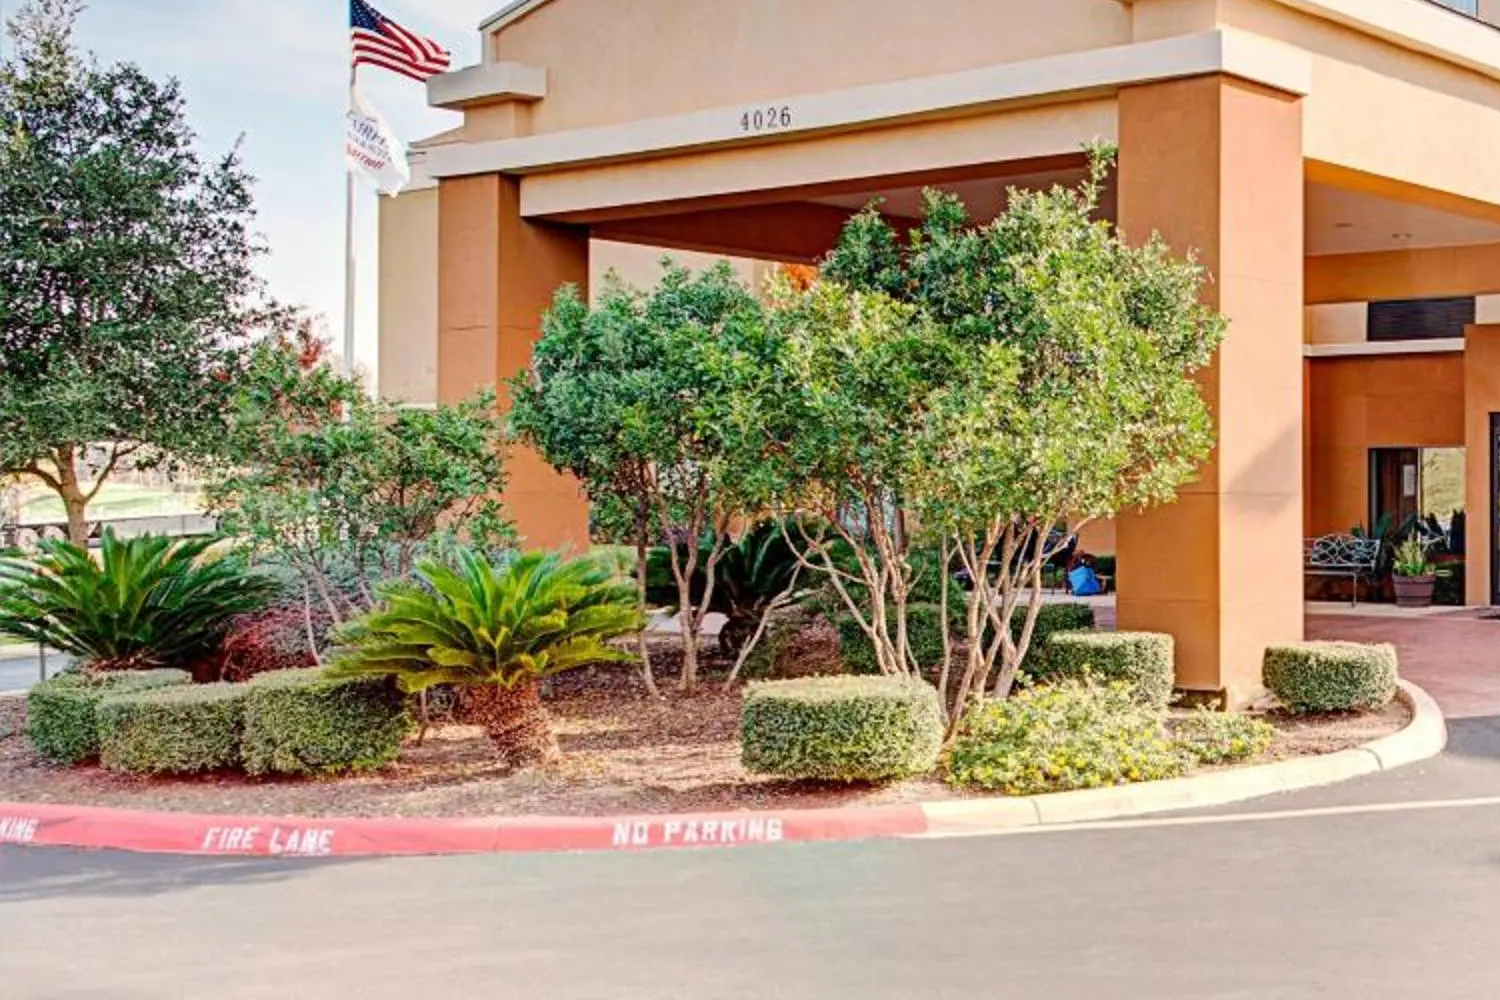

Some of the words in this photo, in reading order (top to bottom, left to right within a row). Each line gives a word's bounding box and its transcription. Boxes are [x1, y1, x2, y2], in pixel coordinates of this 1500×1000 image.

[740, 105, 791, 131] 4026
[201, 826, 259, 851] FIRE
[269, 827, 335, 856] LANE
[613, 822, 650, 846] NO
[663, 817, 783, 843] PARKING
